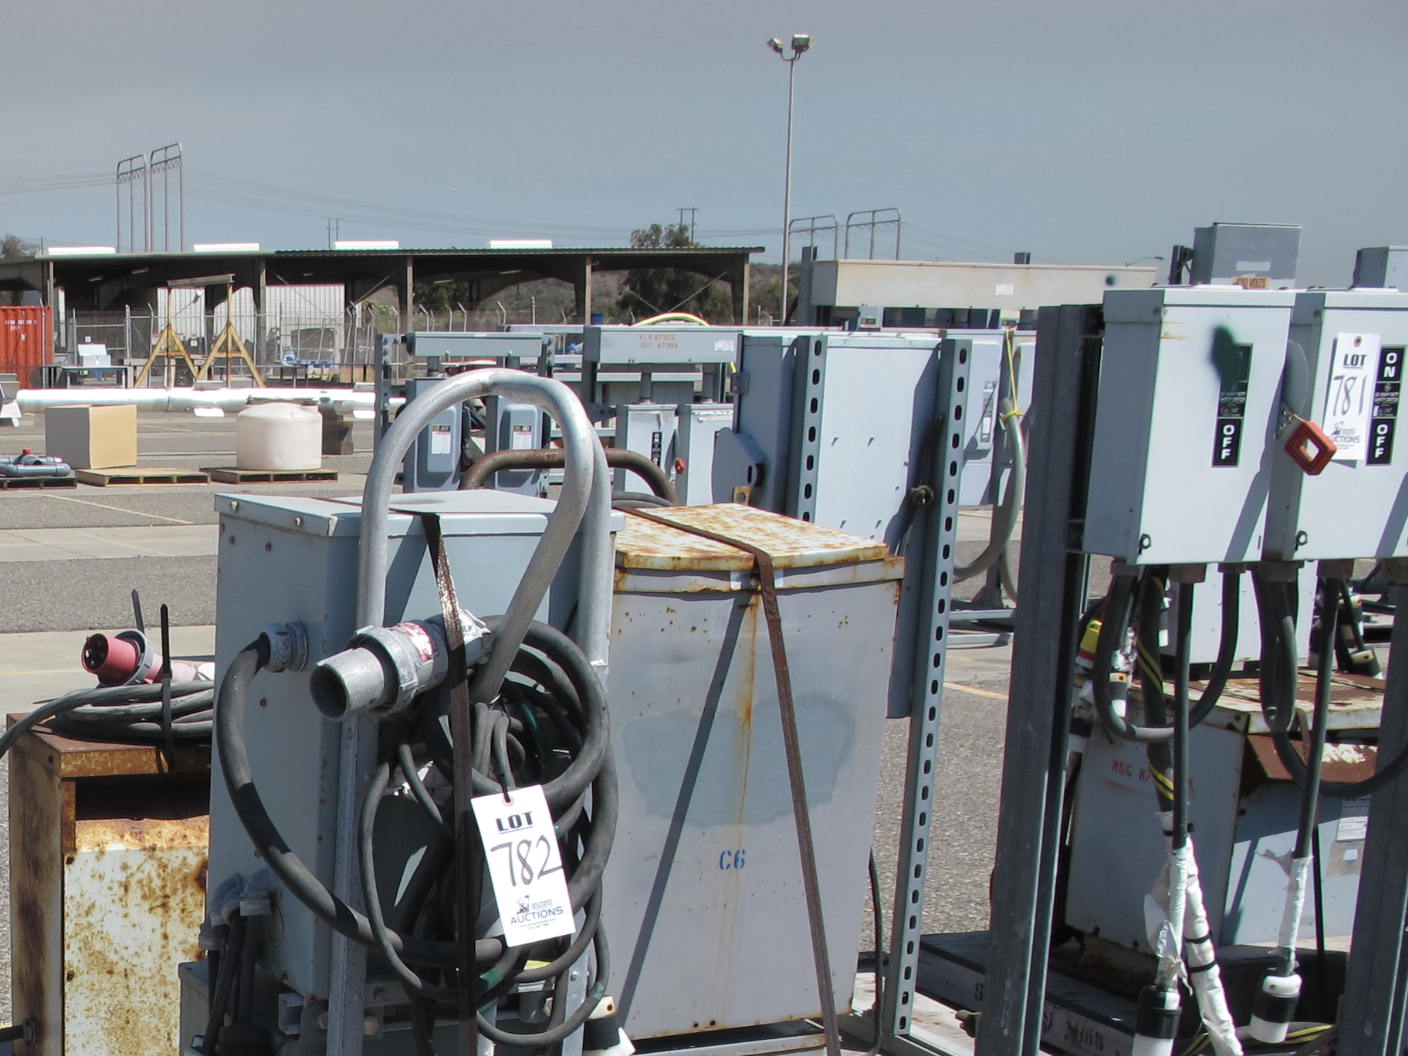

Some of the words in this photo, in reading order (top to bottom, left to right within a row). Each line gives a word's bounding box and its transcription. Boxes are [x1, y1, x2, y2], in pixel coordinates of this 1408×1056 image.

[1343, 353, 1367, 367] LOT
[1384, 352, 1398, 378] ON
[1332, 375, 1367, 417] 781
[1221, 424, 1235, 460] OFF
[1331, 435, 1360, 445] UCTIONS
[1374, 424, 1388, 458] OFF
[496, 811, 534, 832] LOT
[491, 835, 563, 887] 782
[719, 849, 745, 871] C6
[510, 906, 564, 925] AUCTIONS
